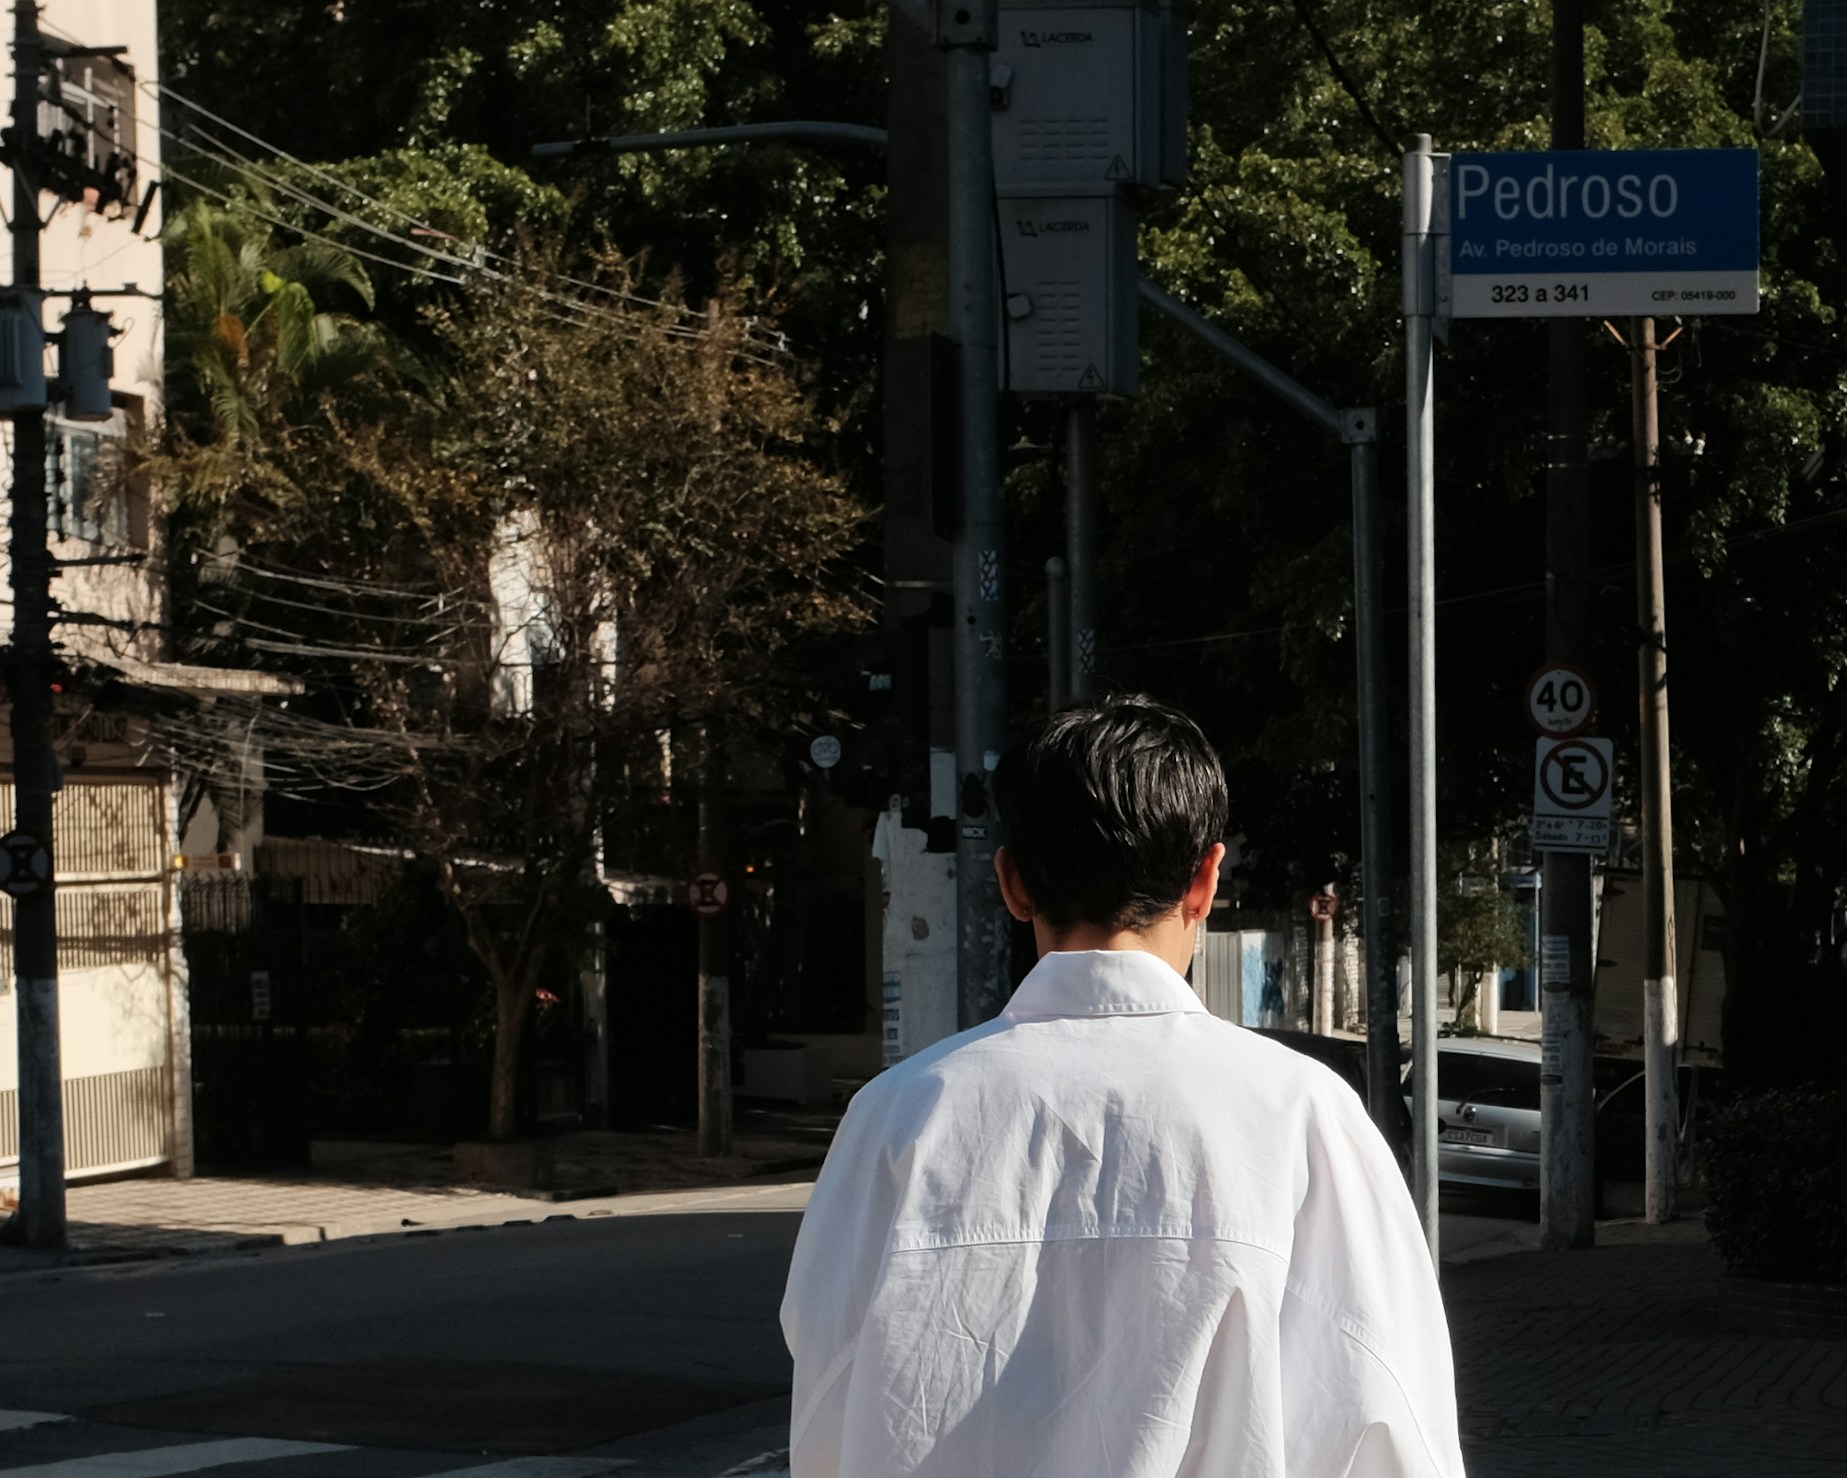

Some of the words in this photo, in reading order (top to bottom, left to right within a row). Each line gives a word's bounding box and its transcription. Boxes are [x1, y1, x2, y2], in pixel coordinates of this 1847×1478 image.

[1042, 32, 1094, 43] LACERDA
[1457, 162, 1678, 221] Pedroso
[1039, 221, 1089, 232] LACERDA
[1459, 240, 1488, 258] Av.
[1496, 239, 1585, 258] Pedroso
[1592, 238, 1618, 257] de
[1625, 237, 1697, 256] Morais
[1491, 284, 1529, 303] 323
[1536, 288, 1547, 302] a
[1554, 284, 1589, 302] 341
[1681, 290, 1736, 301] 05419-000
[1537, 680, 1583, 712] 40
